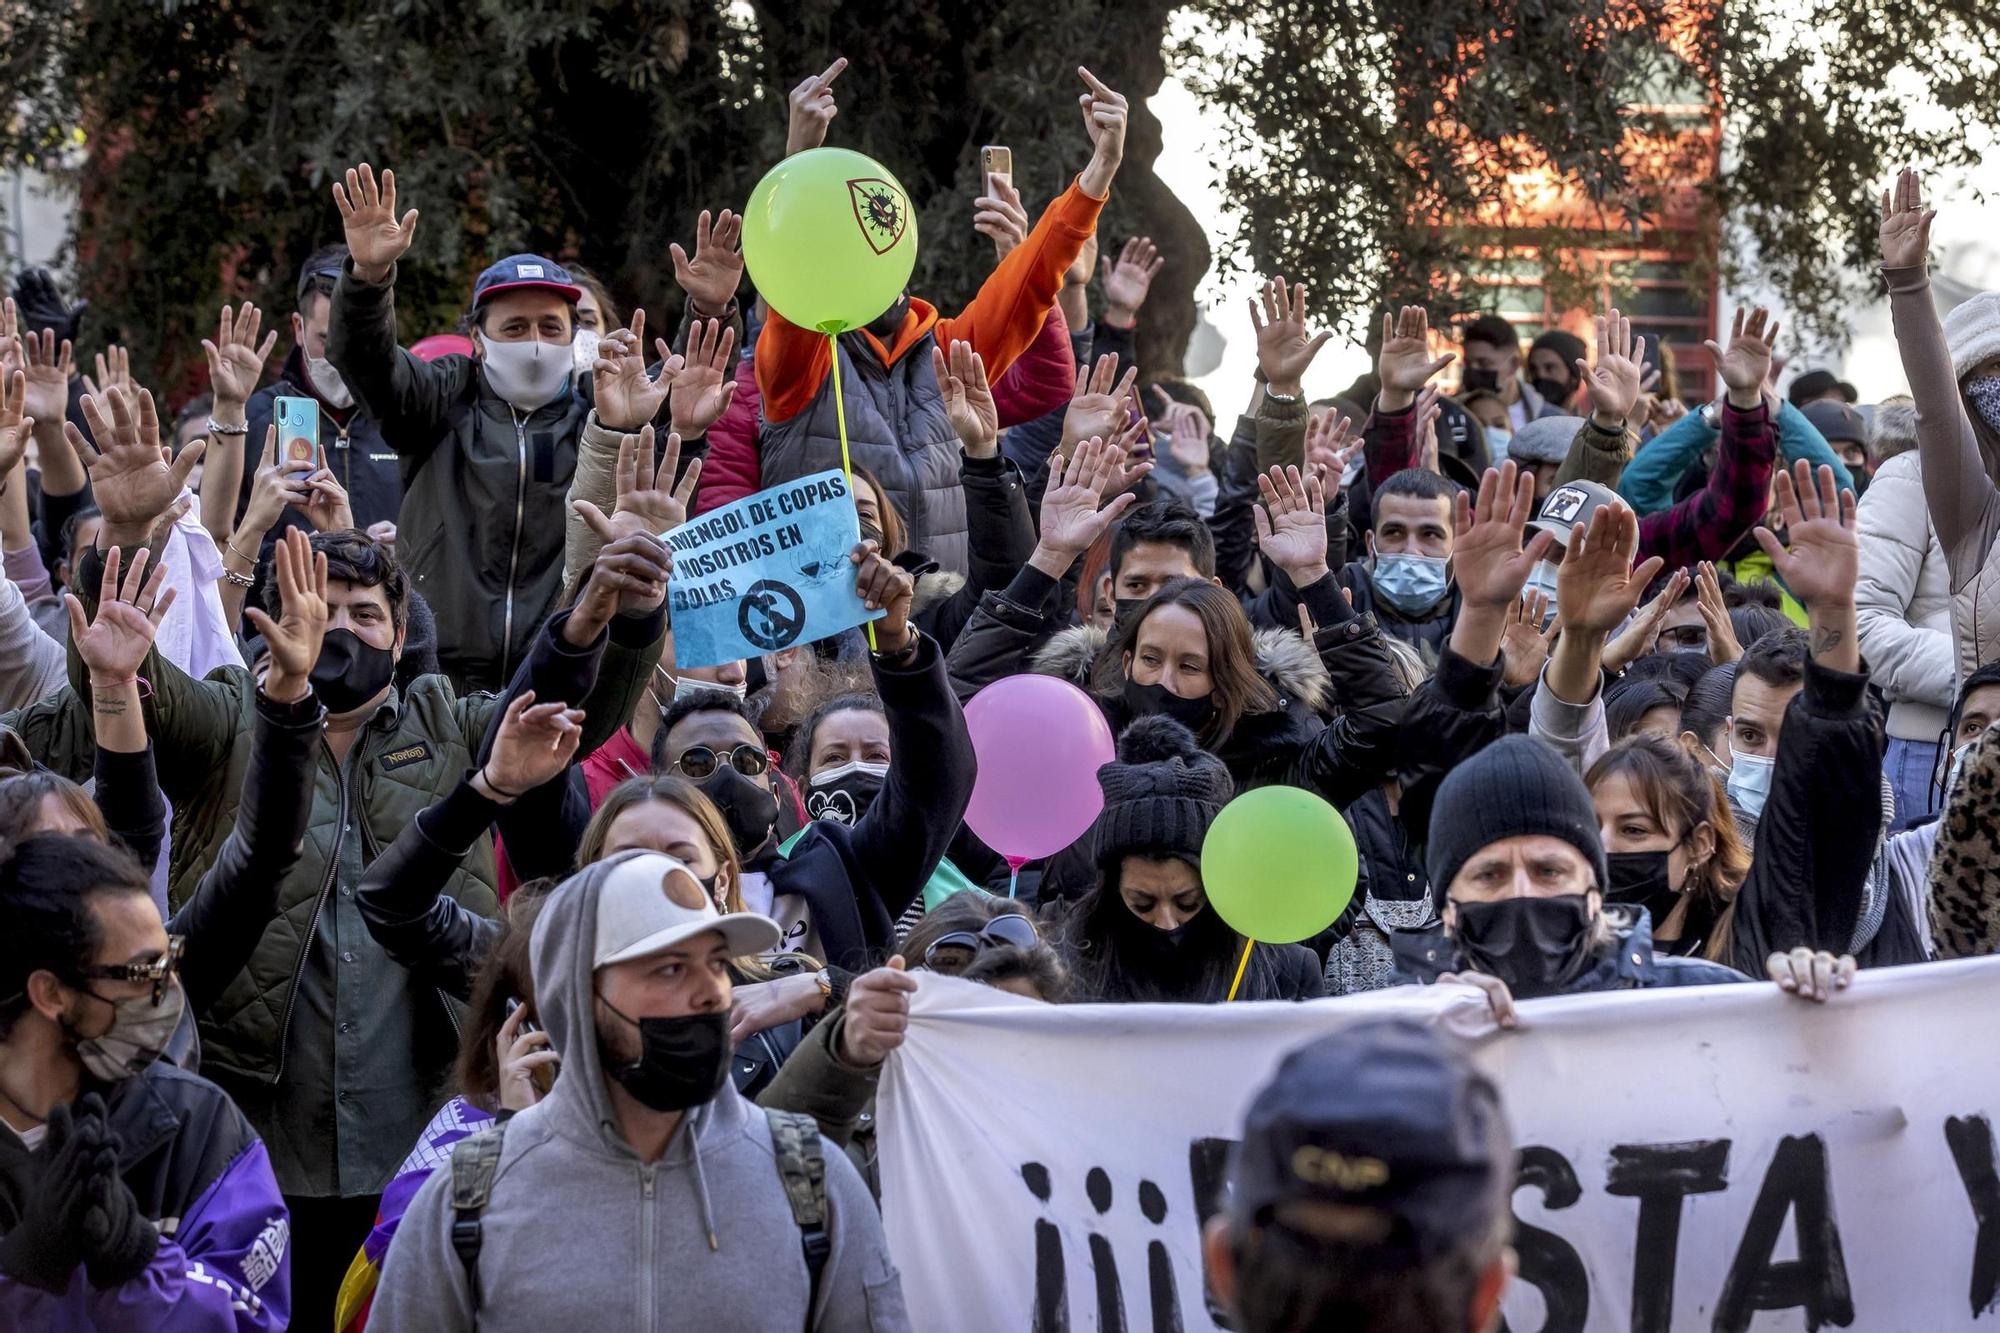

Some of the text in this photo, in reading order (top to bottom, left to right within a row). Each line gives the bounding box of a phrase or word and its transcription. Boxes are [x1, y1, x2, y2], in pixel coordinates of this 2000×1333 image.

[748, 499, 777, 526] DE
[777, 477, 847, 515] COPAS
[677, 523, 804, 579] NOSOTROS EN
[384, 746, 425, 765] Norton
